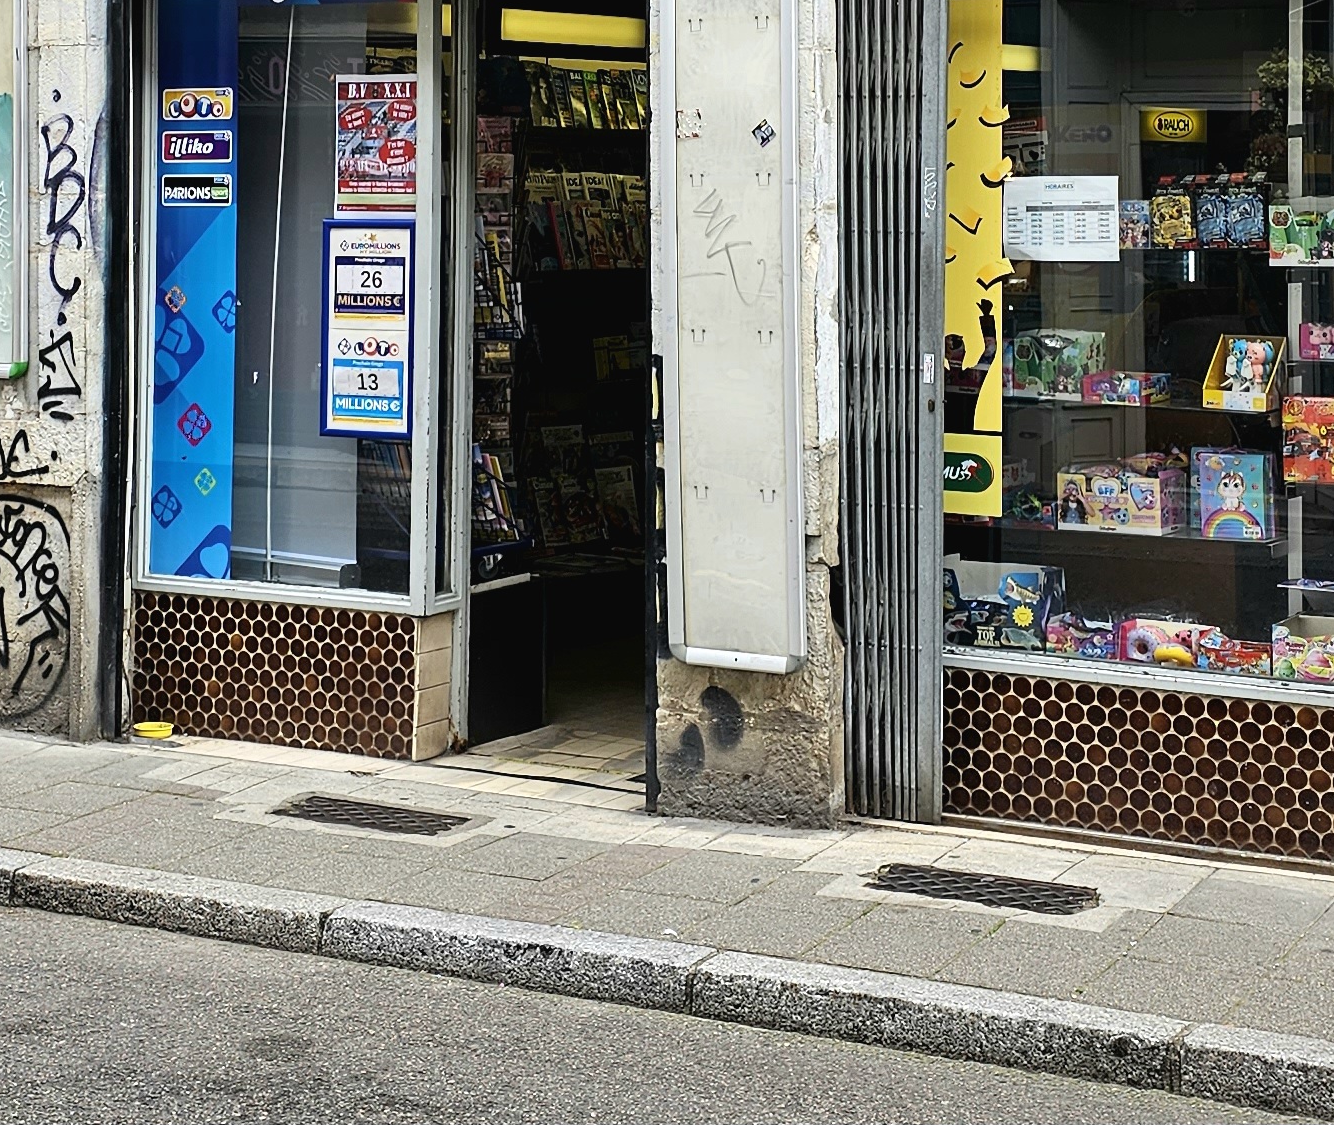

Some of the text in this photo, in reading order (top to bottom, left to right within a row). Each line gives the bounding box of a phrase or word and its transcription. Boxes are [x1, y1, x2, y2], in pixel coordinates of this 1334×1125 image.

[169, 92, 224, 118] LOTO
[1163, 118, 1190, 132] RAUCH
[169, 136, 214, 158] illiko
[164, 186, 211, 200] PARIONS
[350, 242, 401, 250] EUROMILLIONS
[360, 270, 382, 288] 26
[337, 294, 392, 307] MILLIONS
[353, 336, 400, 356] LOTO
[357, 373, 379, 391] 13
[335, 397, 389, 411] MILLIONS
[976, 629, 996, 641] TOP
